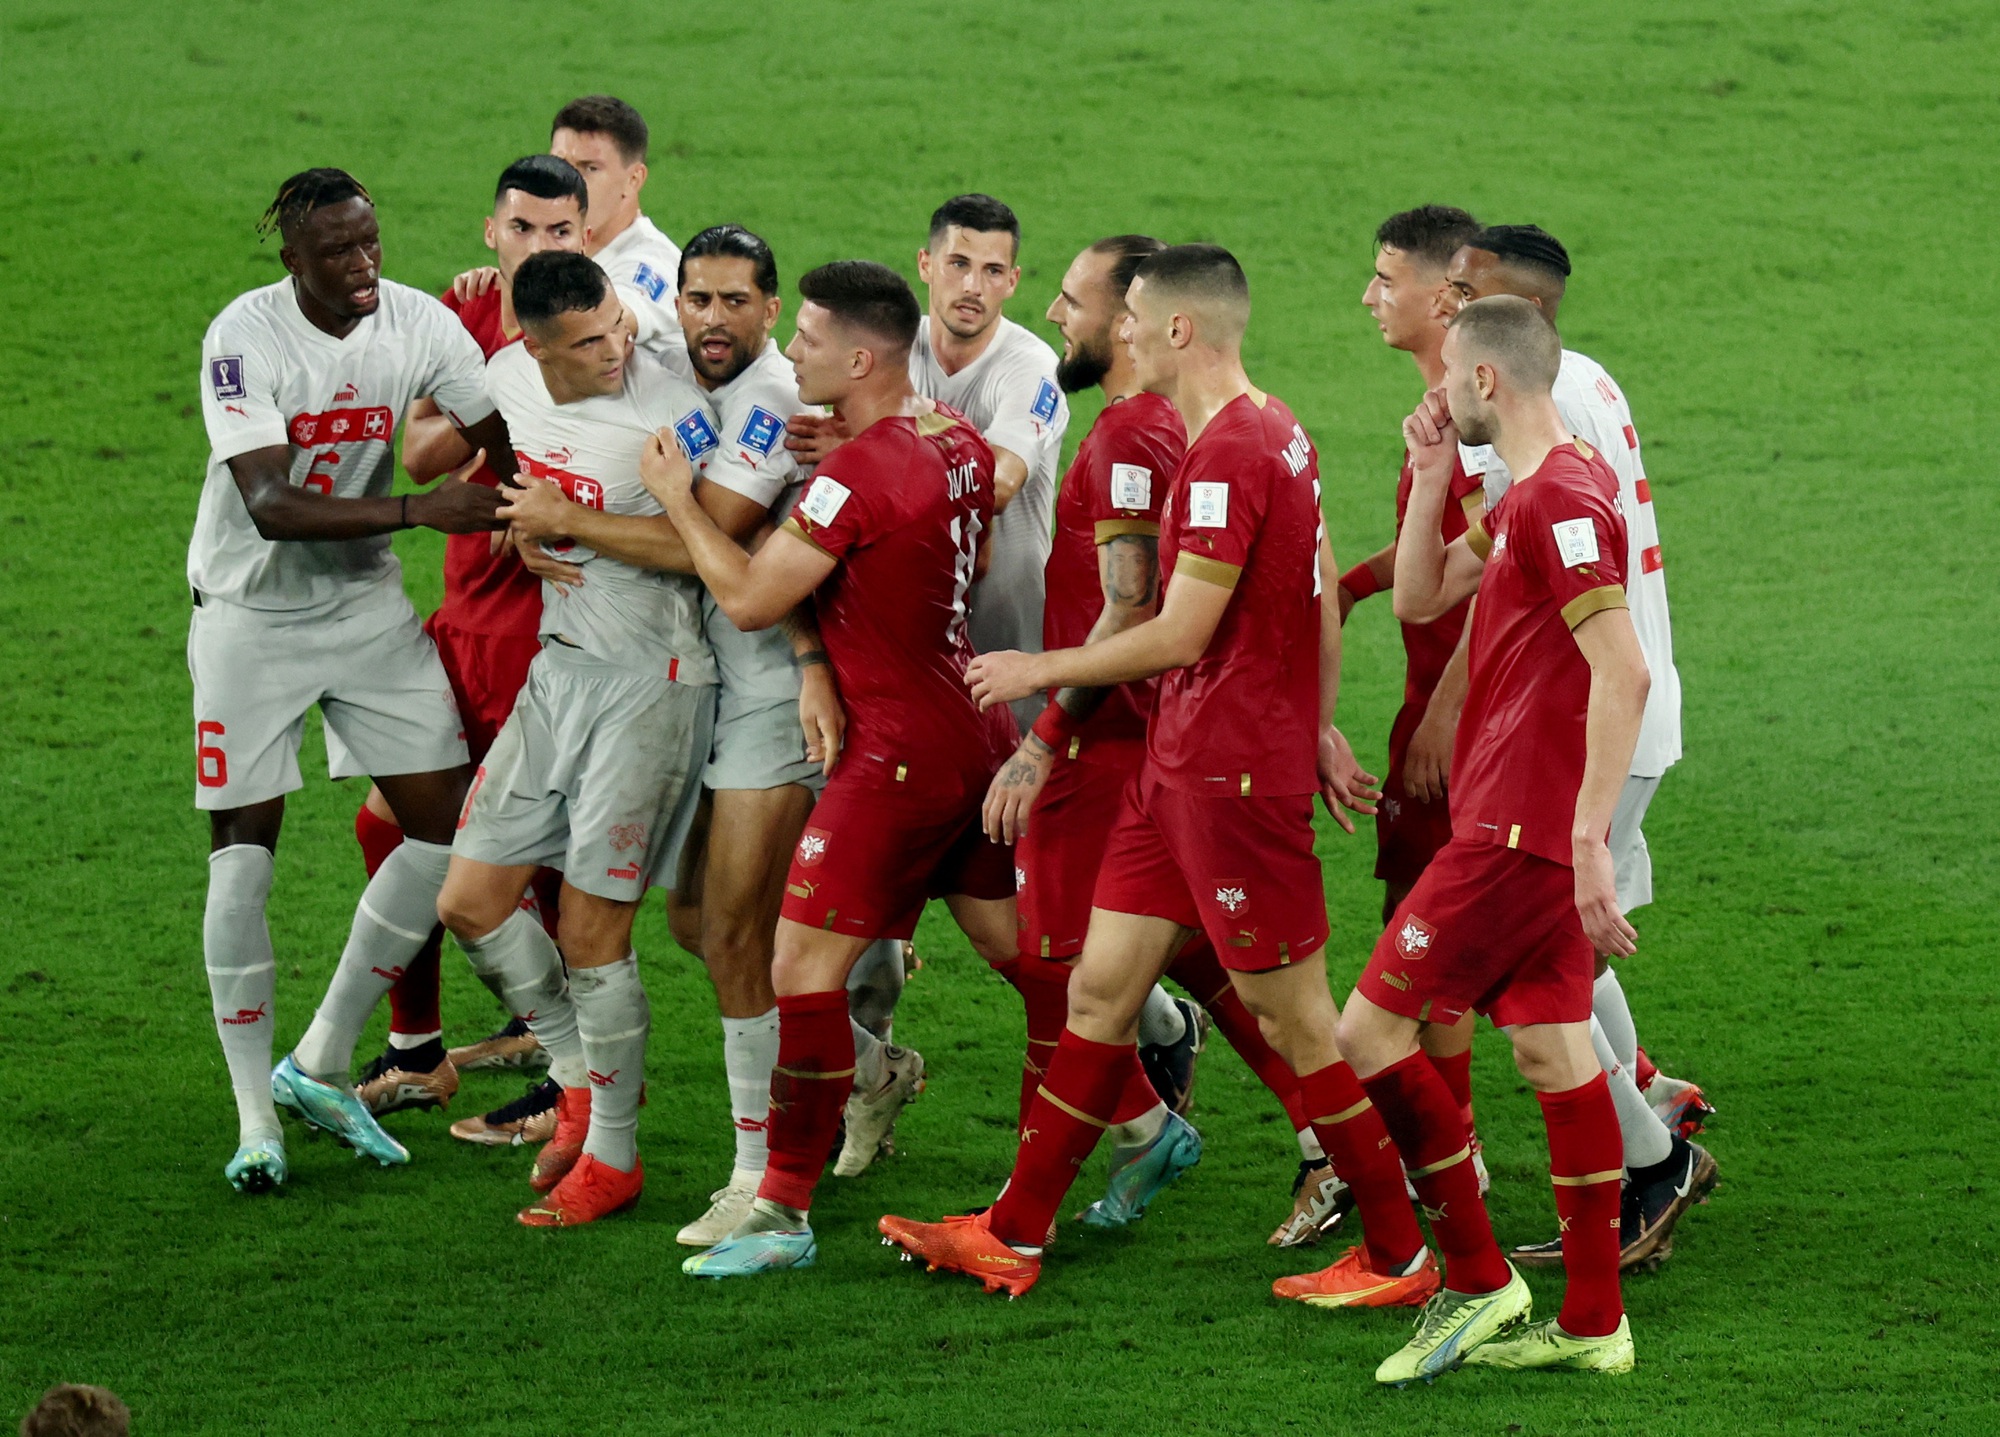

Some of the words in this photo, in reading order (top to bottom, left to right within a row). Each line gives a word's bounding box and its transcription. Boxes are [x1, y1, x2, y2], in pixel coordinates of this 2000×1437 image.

[198, 720, 228, 788] 6
[977, 1253, 1018, 1266] ULTRA
[1559, 1346, 1601, 1361] ULTRA
